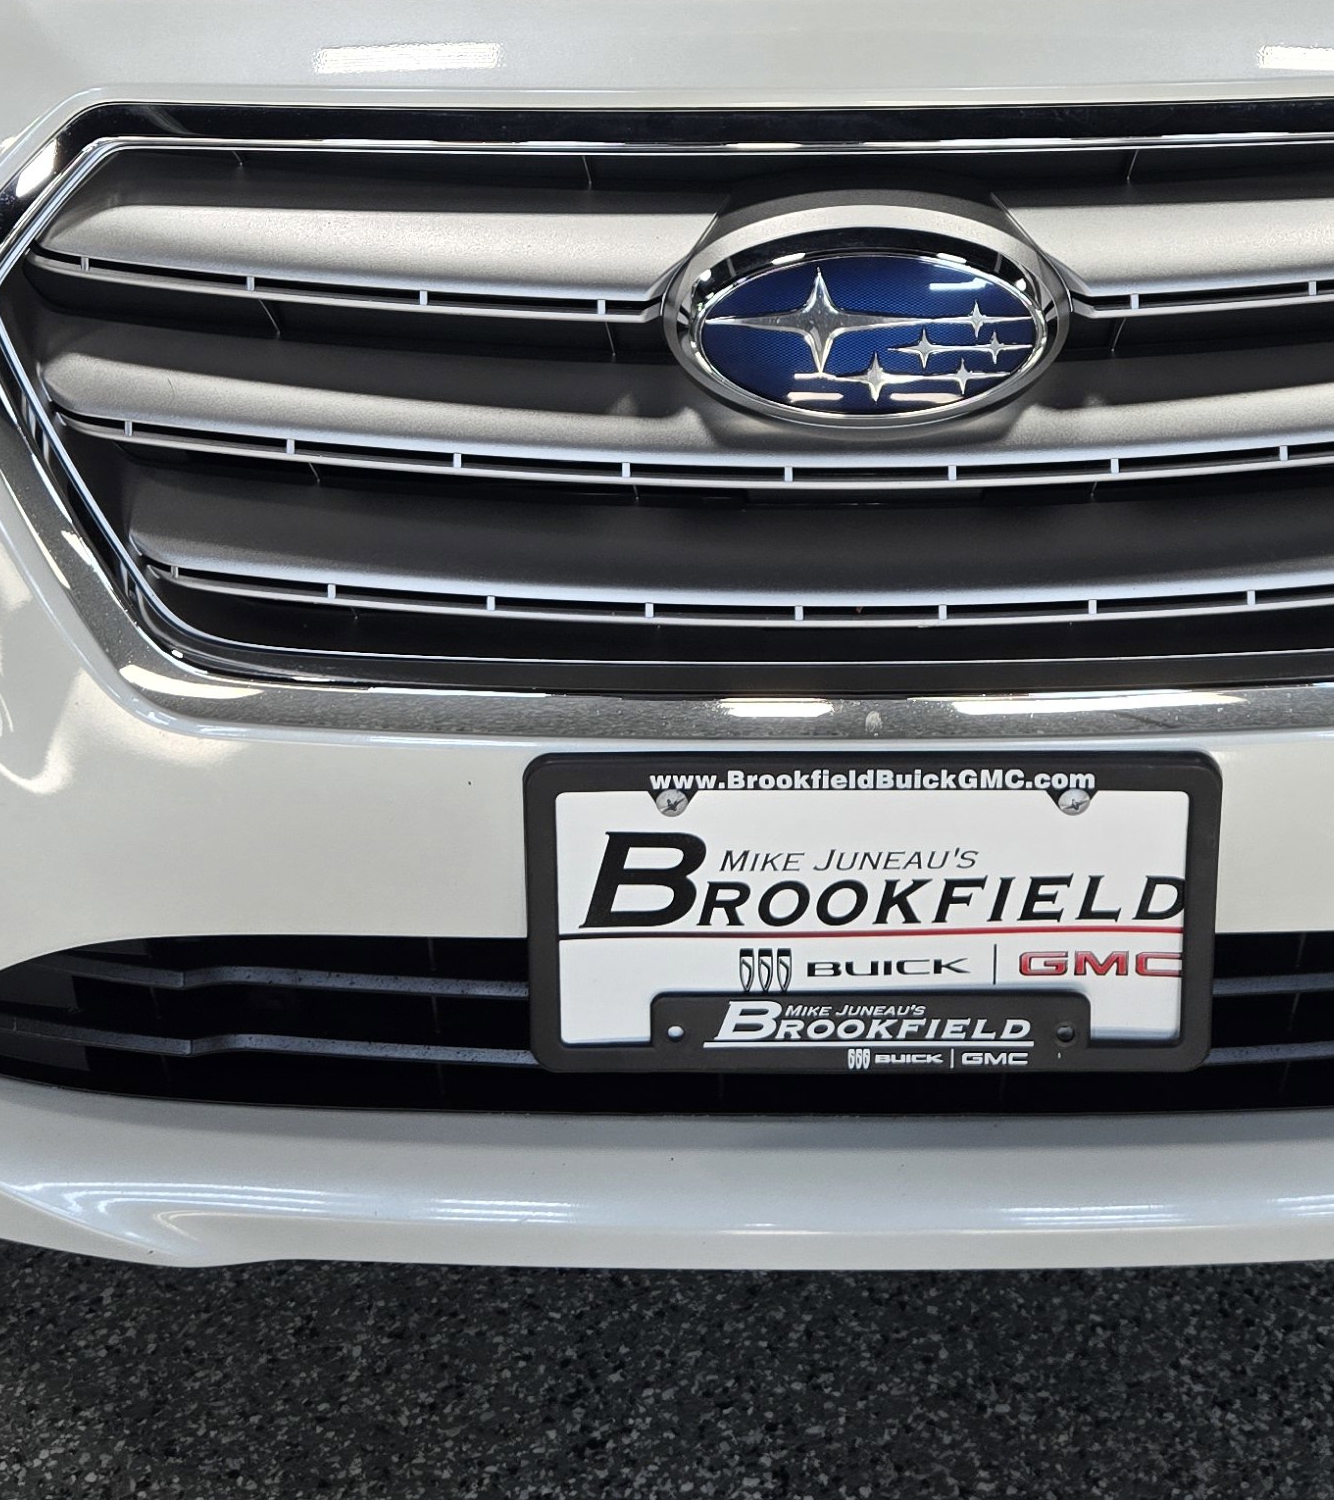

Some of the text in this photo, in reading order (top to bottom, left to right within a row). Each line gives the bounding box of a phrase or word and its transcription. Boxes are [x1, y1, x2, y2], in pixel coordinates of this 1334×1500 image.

[649, 769, 1096, 790] www.BrookfieldBuickGMC.com
[719, 847, 979, 872] MIKE JUNEAU'S
[578, 831, 1185, 929] BROOKFIELD
[806, 950, 1183, 978] BUICK GMC
[714, 1000, 1031, 1041] BROOKFIELD
[785, 1003, 926, 1017] MIKE JUNEAU'S
[874, 1052, 1029, 1065] BUICK GMC
